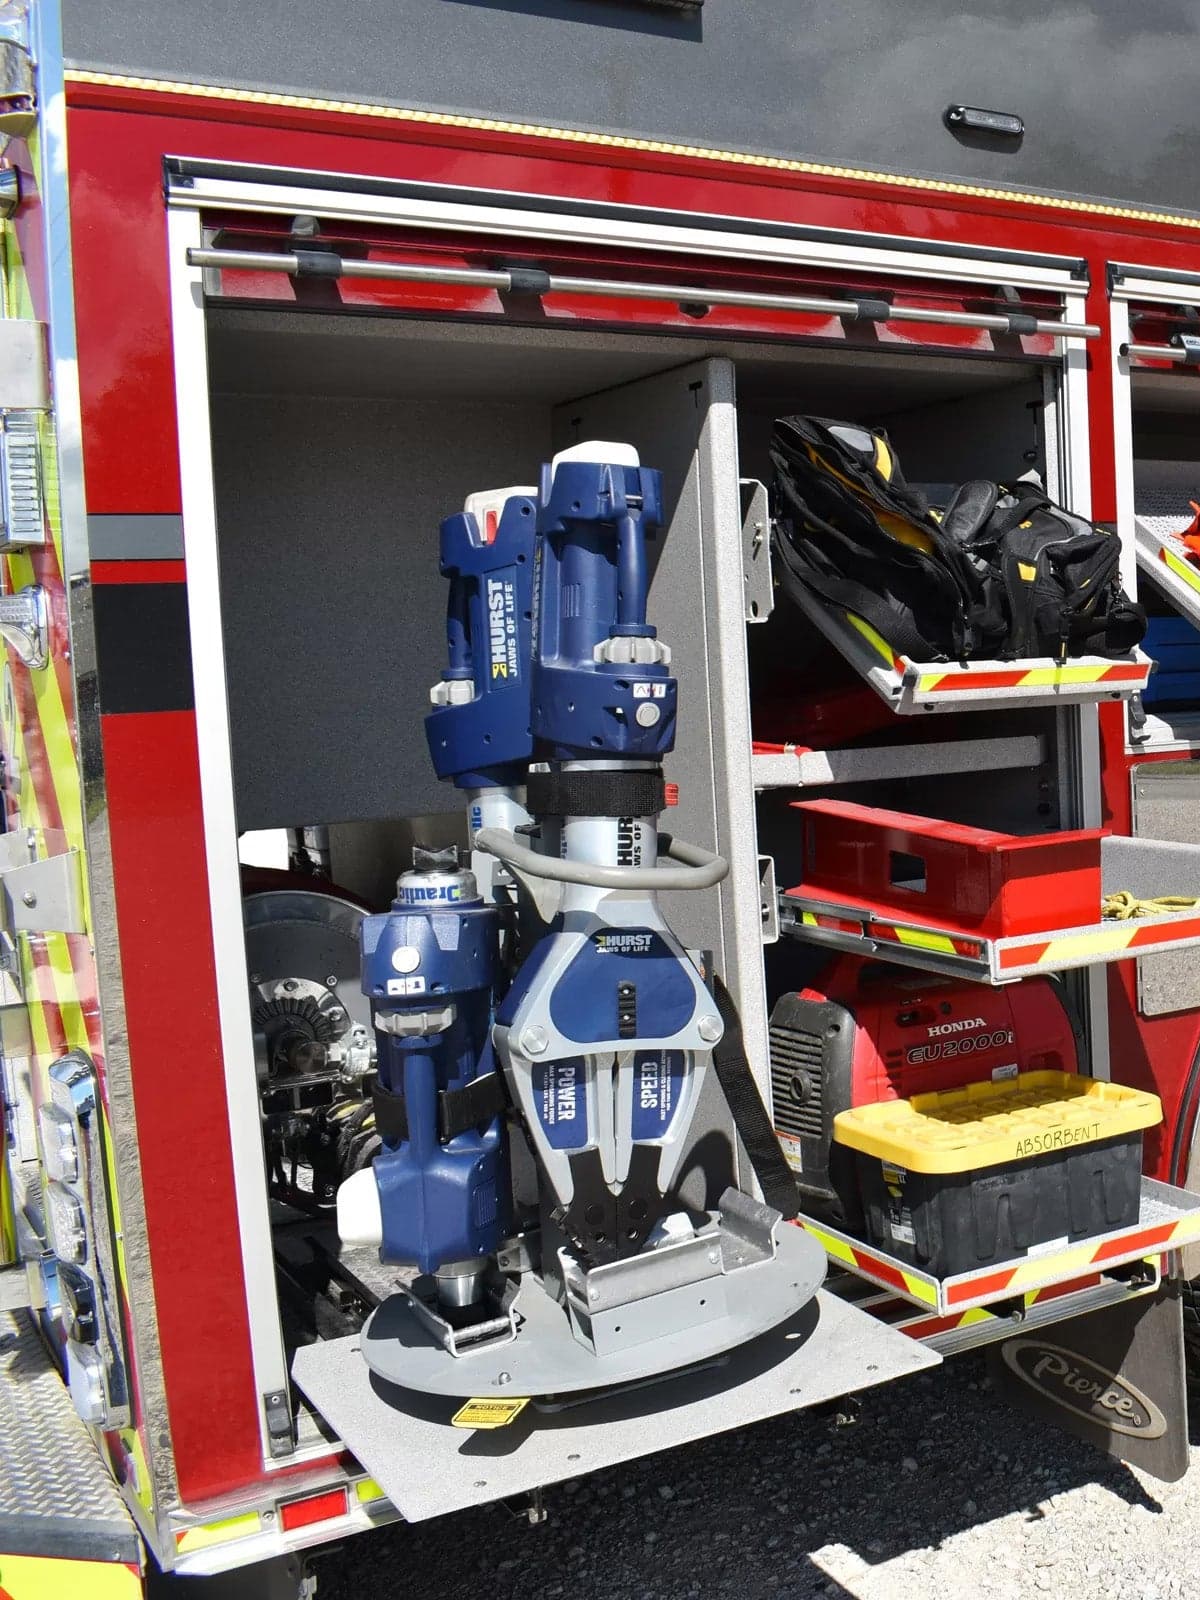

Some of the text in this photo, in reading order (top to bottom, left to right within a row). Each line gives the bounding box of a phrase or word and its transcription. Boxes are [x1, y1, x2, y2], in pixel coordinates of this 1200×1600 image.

[487, 579, 507, 663] HURST
[504, 584, 518, 677] JAWS OF LIFE
[617, 817, 633, 866] HUR
[634, 823, 641, 841] OF
[606, 934, 653, 947] HURST
[906, 1029, 1014, 1065] EU2000i
[927, 1017, 987, 1038] HONDA
[558, 1067, 576, 1121] POWER
[640, 1061, 658, 1109] SPEED
[1015, 1122, 1102, 1157] ABSORBENT
[1032, 1351, 1135, 1419] Pierce
